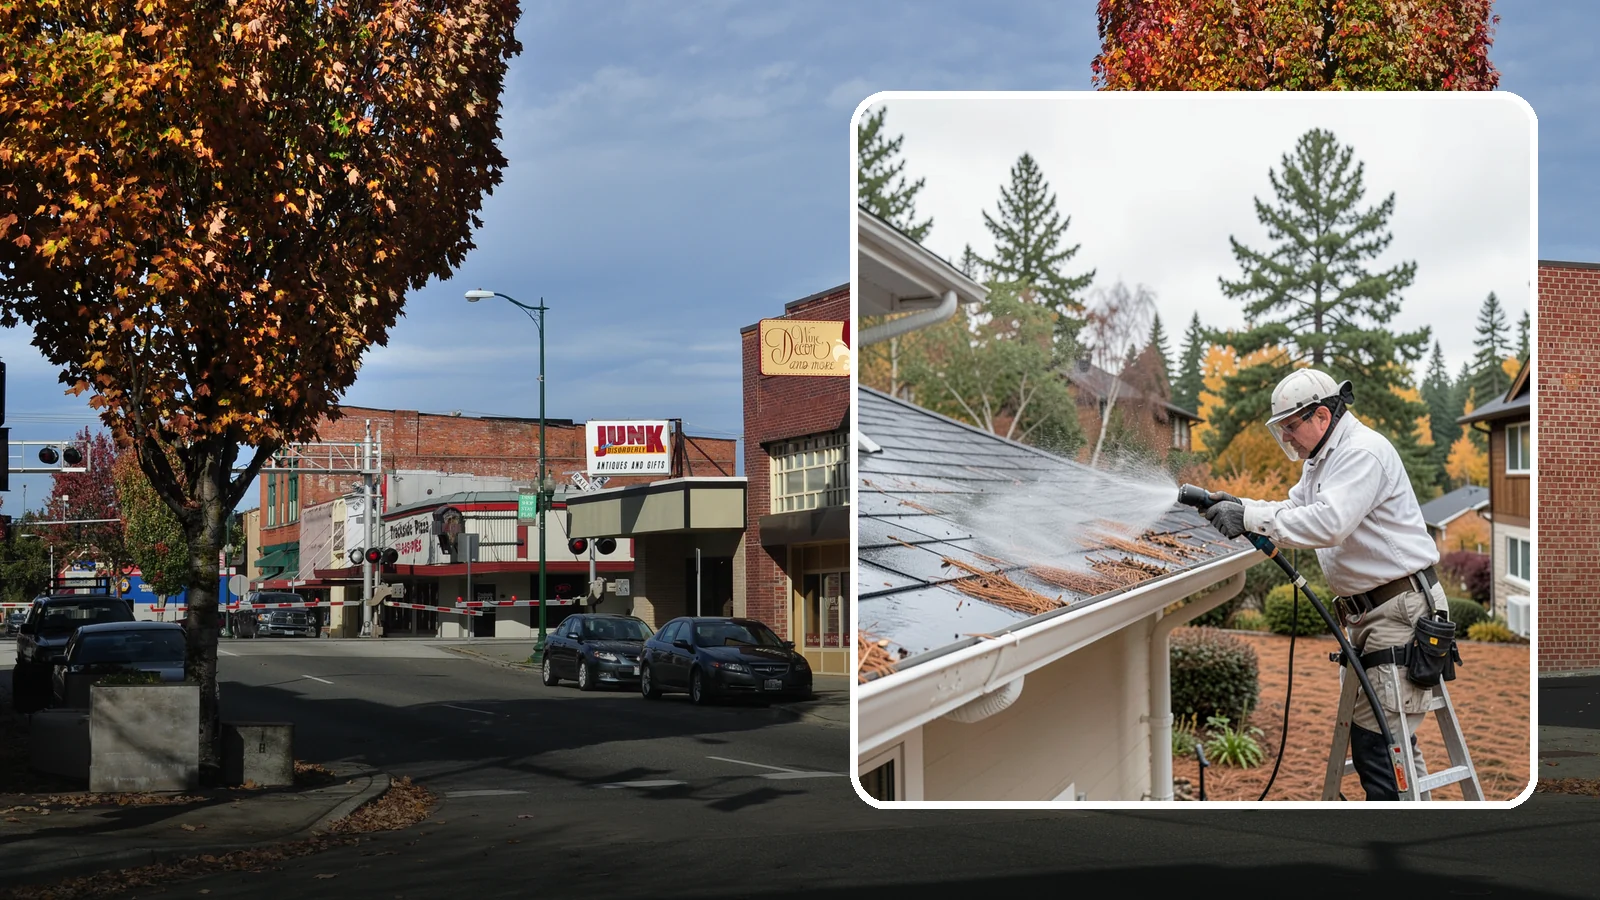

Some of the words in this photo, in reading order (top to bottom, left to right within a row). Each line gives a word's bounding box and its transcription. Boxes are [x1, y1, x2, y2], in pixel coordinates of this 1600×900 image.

[595, 425, 665, 457] JUNK
[607, 446, 646, 454] DISORDERLY
[597, 461, 628, 470] ANTIQUES
[631, 461, 644, 470] AND
[647, 460, 665, 469] GIFTS
[390, 521, 413, 539] Trackside
[414, 519, 429, 535] Pizza
